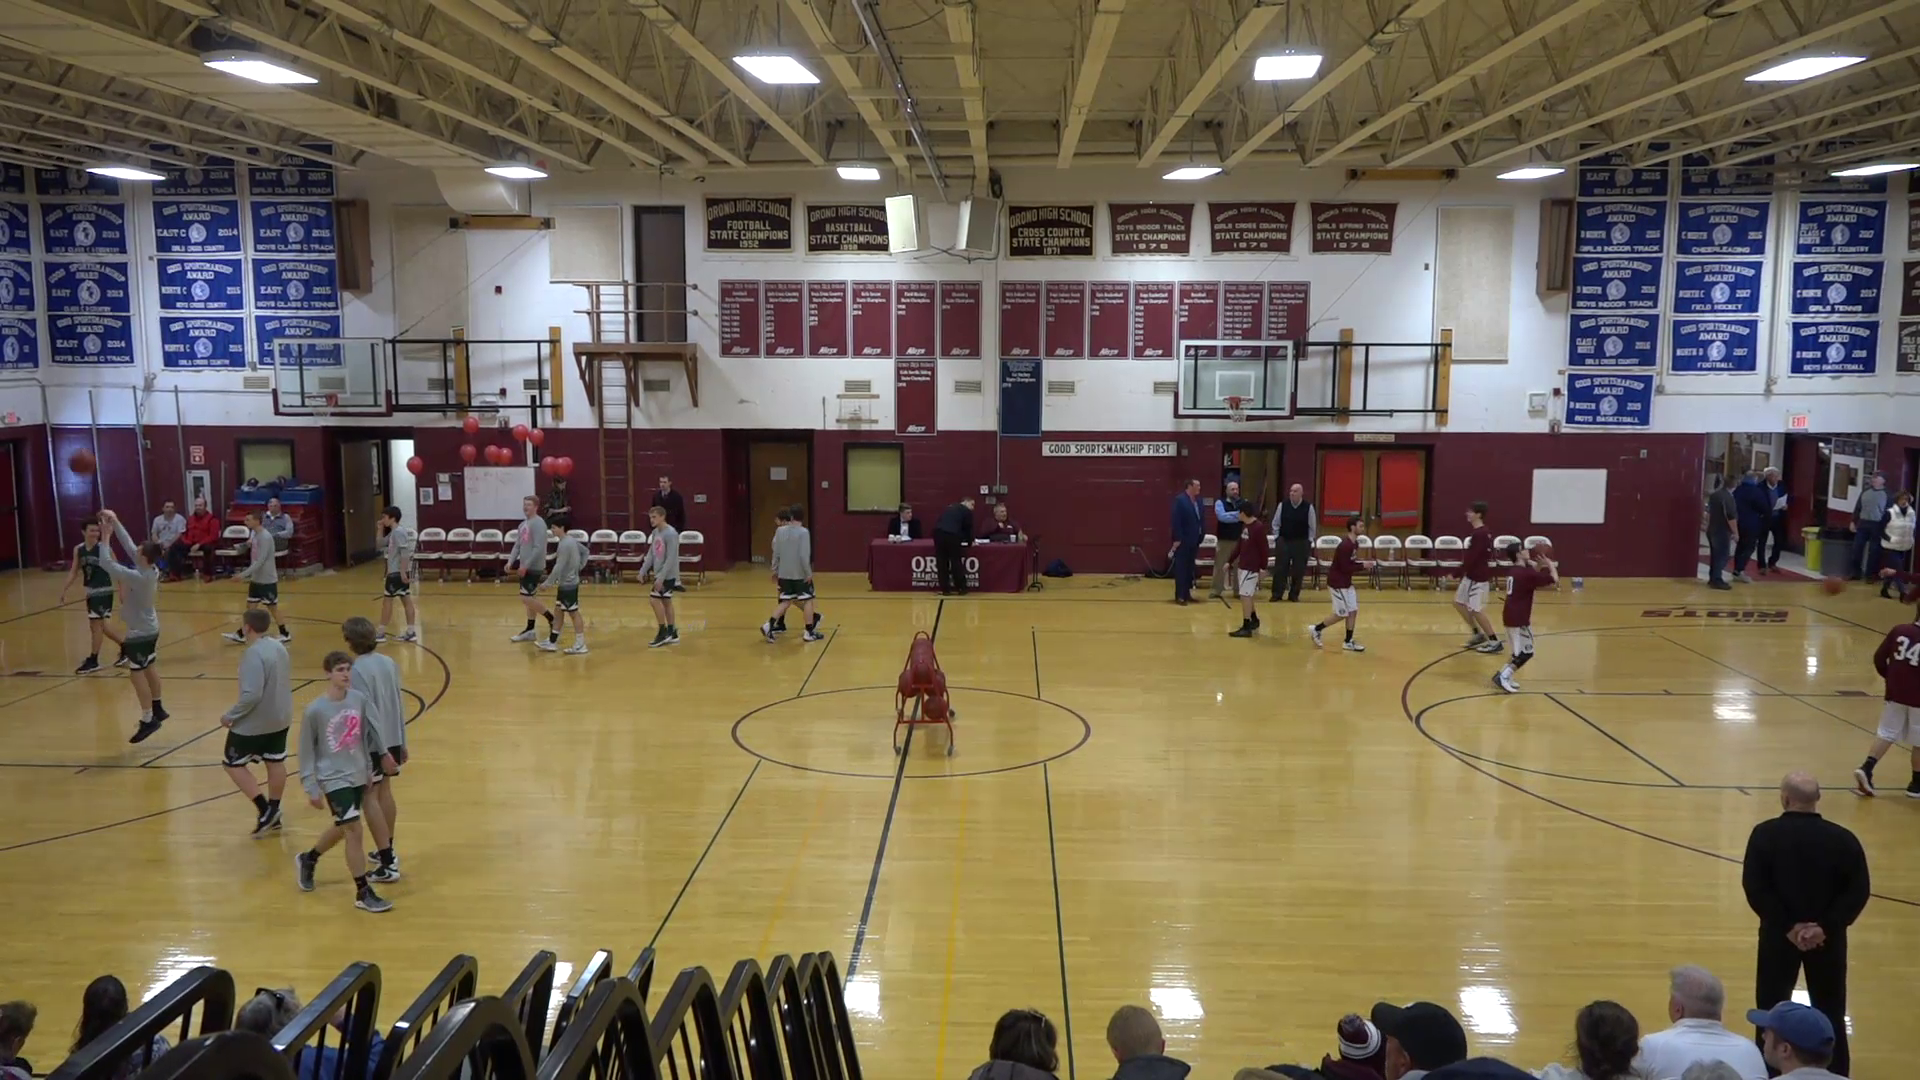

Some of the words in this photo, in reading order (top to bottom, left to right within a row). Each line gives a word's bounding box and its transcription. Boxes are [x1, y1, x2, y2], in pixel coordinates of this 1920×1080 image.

[255, 172, 277, 180] EAST
[708, 203, 735, 221] ORONO
[736, 200, 756, 213] HIGH
[757, 200, 790, 221] SCHOOL
[810, 209, 837, 223] ORONO
[838, 206, 858, 217] HIGH
[182, 212, 211, 220] AWARD
[280, 213, 309, 221] AWARD
[1010, 209, 1038, 228] ORONO
[1039, 207, 1058, 221] HIGH
[1059, 207, 1092, 228] SCHOOL
[1117, 210, 1138, 223] ORONO
[1607, 214, 1636, 223] AWARD
[1709, 215, 1738, 223] AWARD
[1826, 214, 1857, 223] AWARD
[726, 220, 771, 231] FOOTBALL
[825, 223, 873, 232] BASKETBALL
[1259, 223, 1288, 231] COUNTRY
[157, 228, 178, 237] EAST
[218, 228, 239, 236] 2014
[260, 229, 281, 237] EAST
[312, 229, 331, 237] 2015
[710, 230, 739, 240] STATE
[740, 230, 789, 240] CHAMPIONS
[1018, 228, 1045, 237] CROSS
[1047, 228, 1085, 237] COUNTRY
[1115, 233, 1139, 241] STATE
[1142, 233, 1187, 241] CHAMPIONS
[1215, 232, 1240, 240] STATE
[1243, 232, 1287, 240] CHAMPIONS
[1316, 232, 1340, 240] STATE
[1344, 232, 1389, 240] CHAMPIONS
[739, 240, 760, 248] 1952
[810, 235, 838, 245] STATE
[841, 235, 889, 245] CHAMPIONS
[1012, 238, 1040, 247] STATE
[1042, 237, 1090, 247] CHAMPIONS
[1044, 247, 1060, 255] 1971
[186, 271, 215, 279] AWARD
[281, 271, 310, 279] AWARD
[1602, 269, 1631, 278] AWARD
[1704, 273, 1735, 282] AWARD
[1822, 273, 1853, 282] AWARD
[260, 286, 282, 294] EAST
[312, 286, 332, 294] 2015
[76, 325, 104, 333] AWARD
[189, 329, 217, 337] AWARD
[1599, 325, 1629, 334] AWARD
[1698, 331, 1729, 340] AWARD
[1819, 334, 1849, 342] AWARD
[56, 339, 79, 348] EAST
[107, 339, 126, 348] 2014
[1594, 385, 1624, 395] AWARD
[1792, 416, 1806, 427] EXIT
[1049, 444, 1071, 454] GOOD
[1075, 443, 1144, 454] SPORTSMANSHIP
[1147, 443, 1171, 454] FIRST
[911, 556, 979, 573] ORO
[1641, 609, 1788, 618] RIOTS
[1893, 635, 1920, 667] 34
